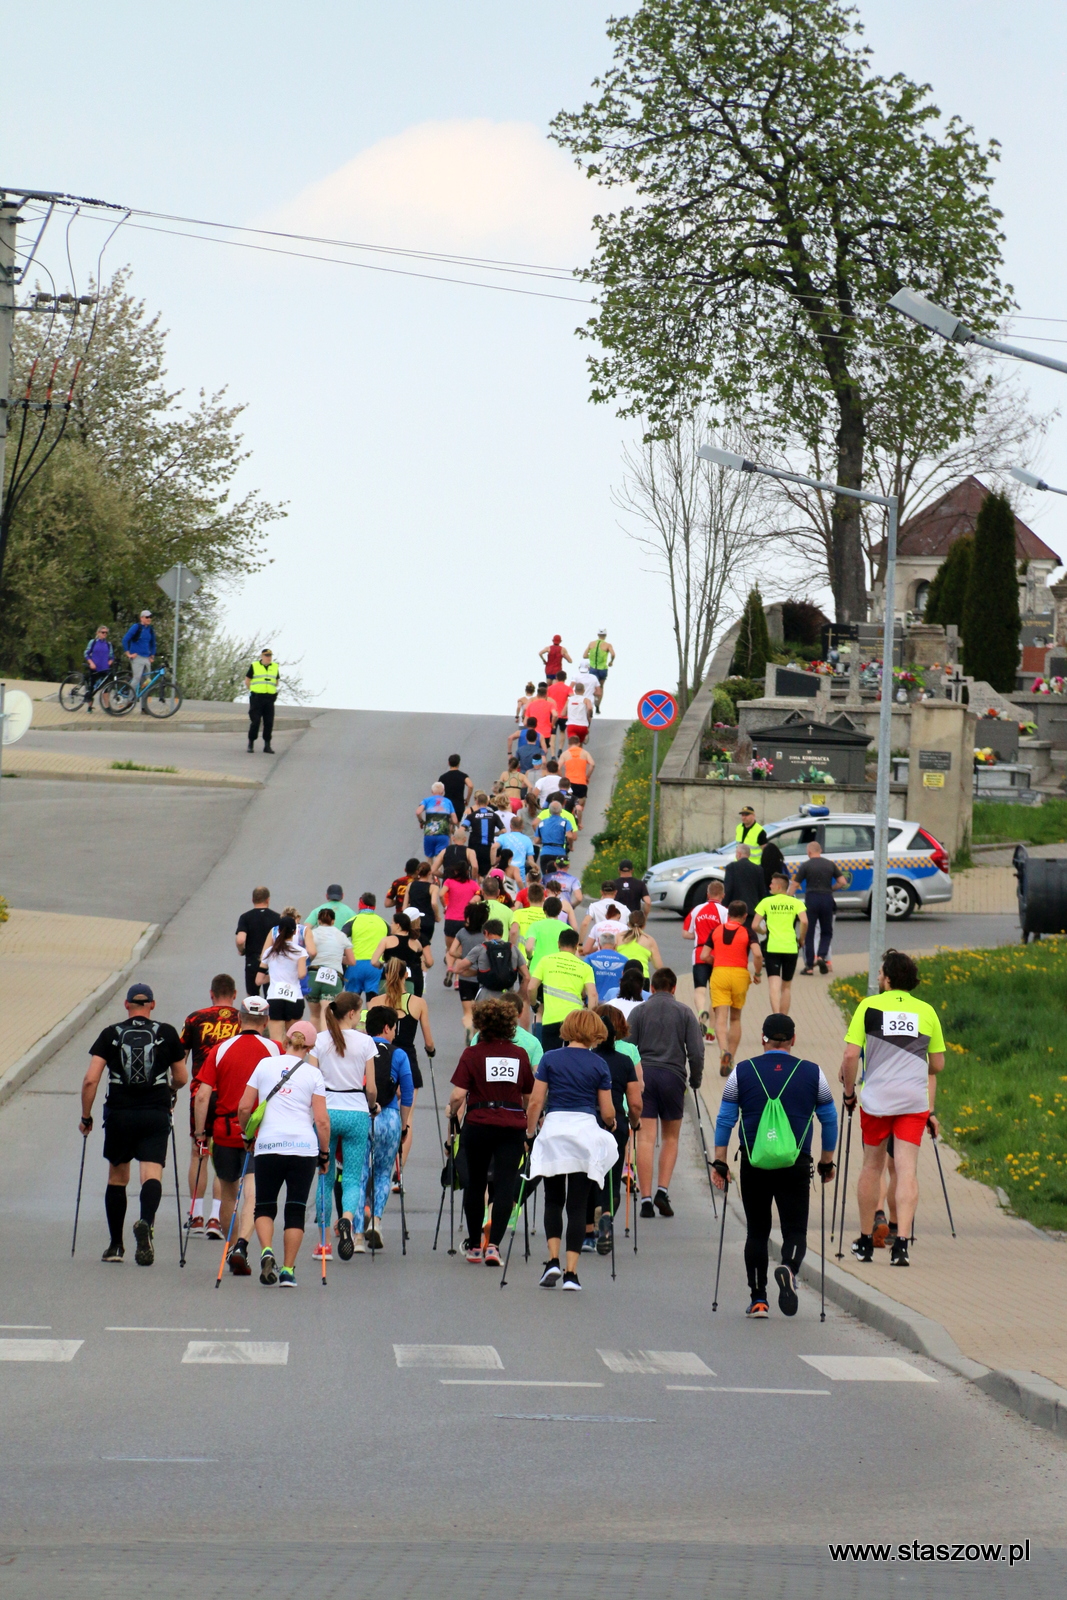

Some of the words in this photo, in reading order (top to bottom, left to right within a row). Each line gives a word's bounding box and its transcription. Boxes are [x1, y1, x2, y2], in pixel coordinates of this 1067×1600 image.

[696, 913, 719, 924] POLSKA
[320, 972, 335, 982] 392
[278, 988, 294, 997] 361
[889, 1020, 914, 1032] 326
[490, 1066, 514, 1078] 325
